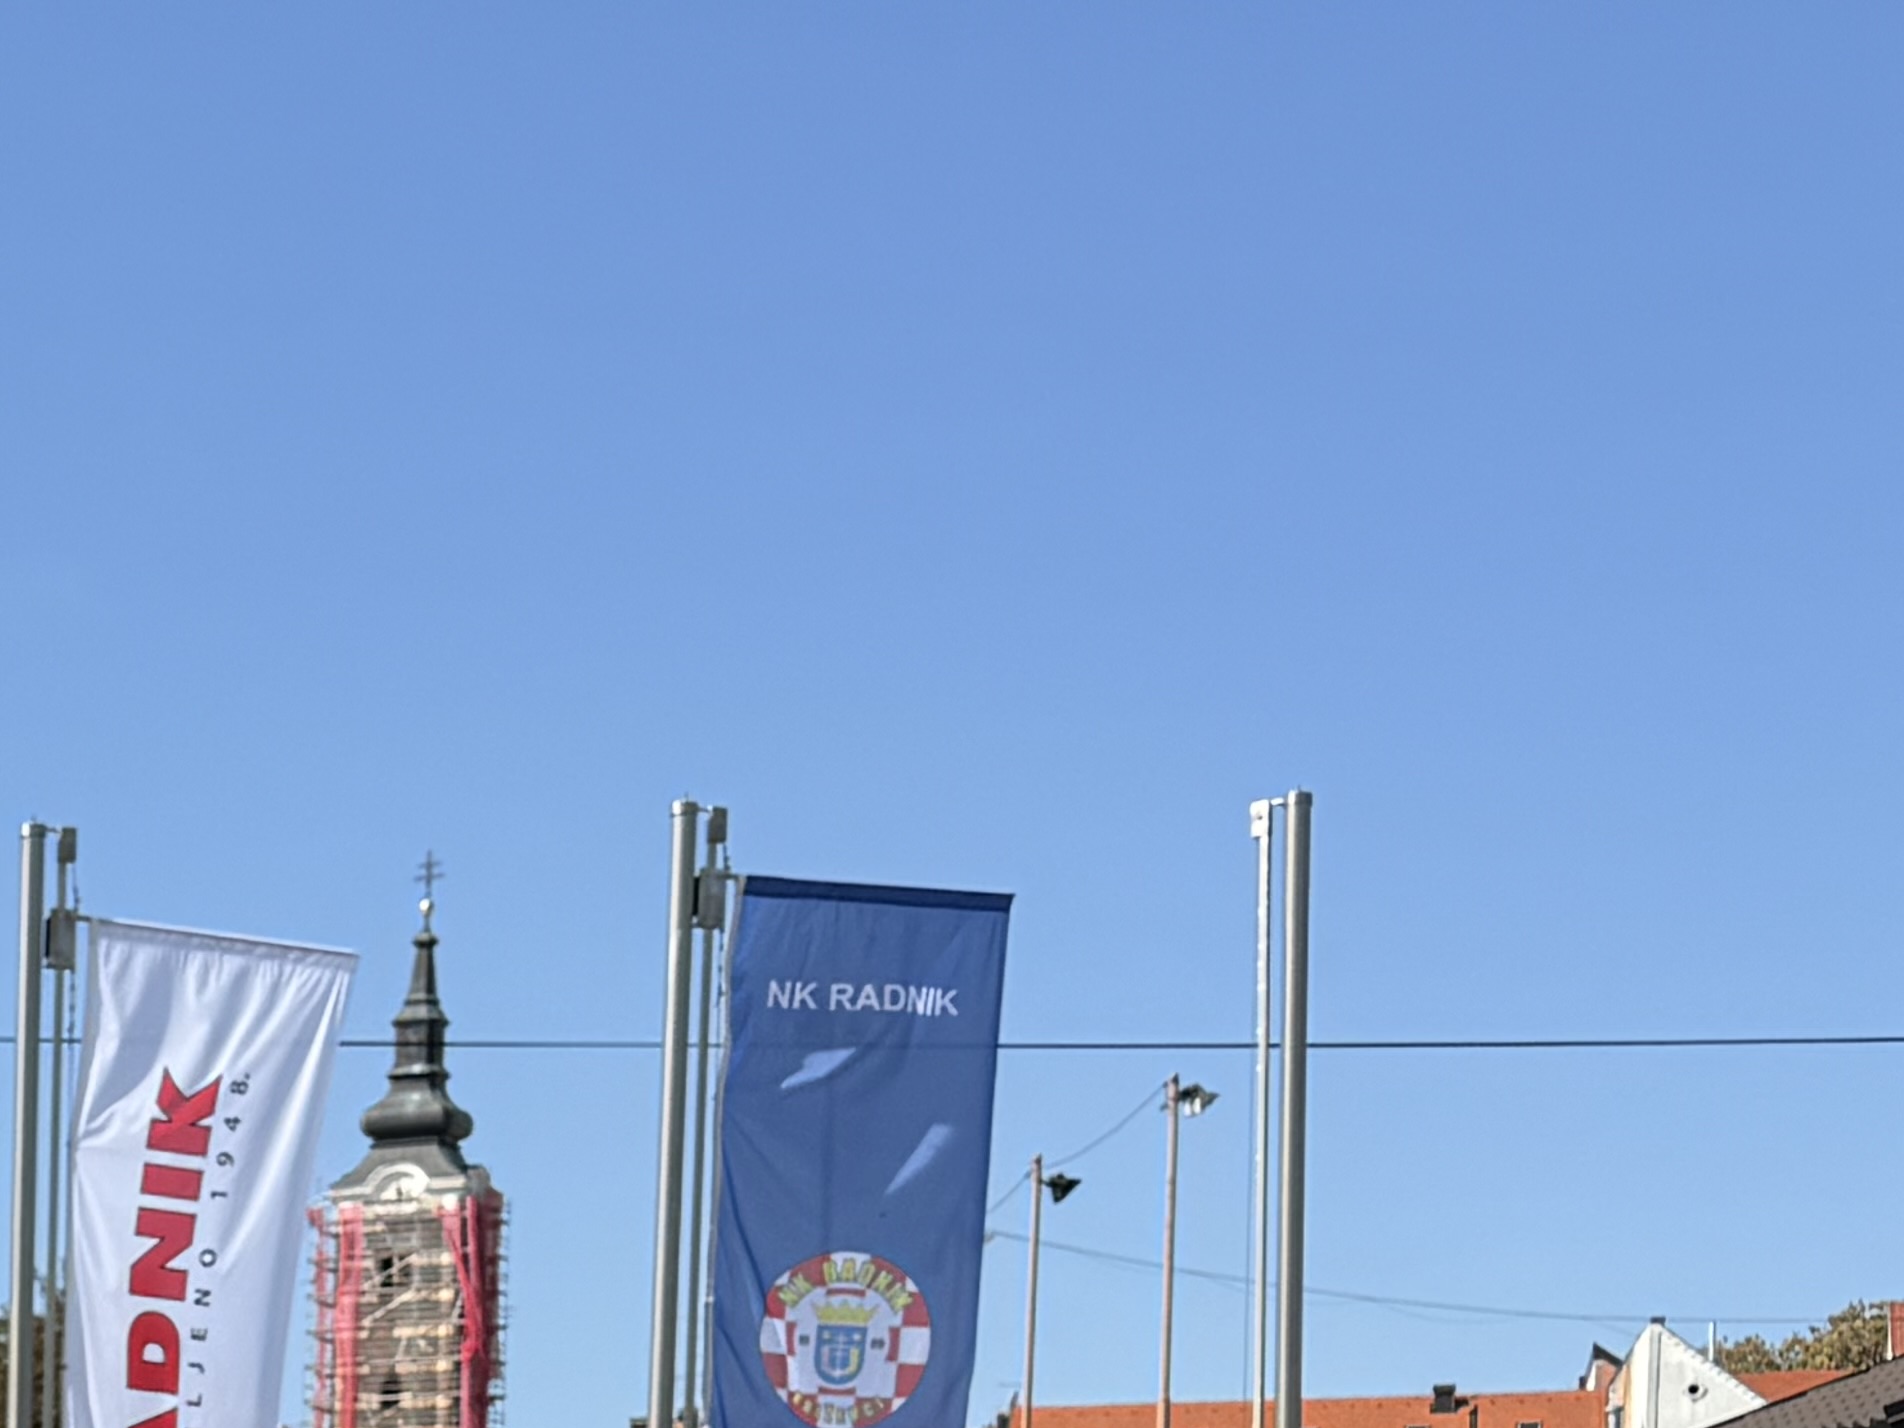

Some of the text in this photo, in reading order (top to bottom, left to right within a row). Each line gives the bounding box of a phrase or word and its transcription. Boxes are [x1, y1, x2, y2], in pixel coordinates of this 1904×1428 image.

[767, 979, 959, 1017] NK RADNIK
[209, 1072, 252, 1200] 1948.
[778, 1273, 814, 1309] NK
